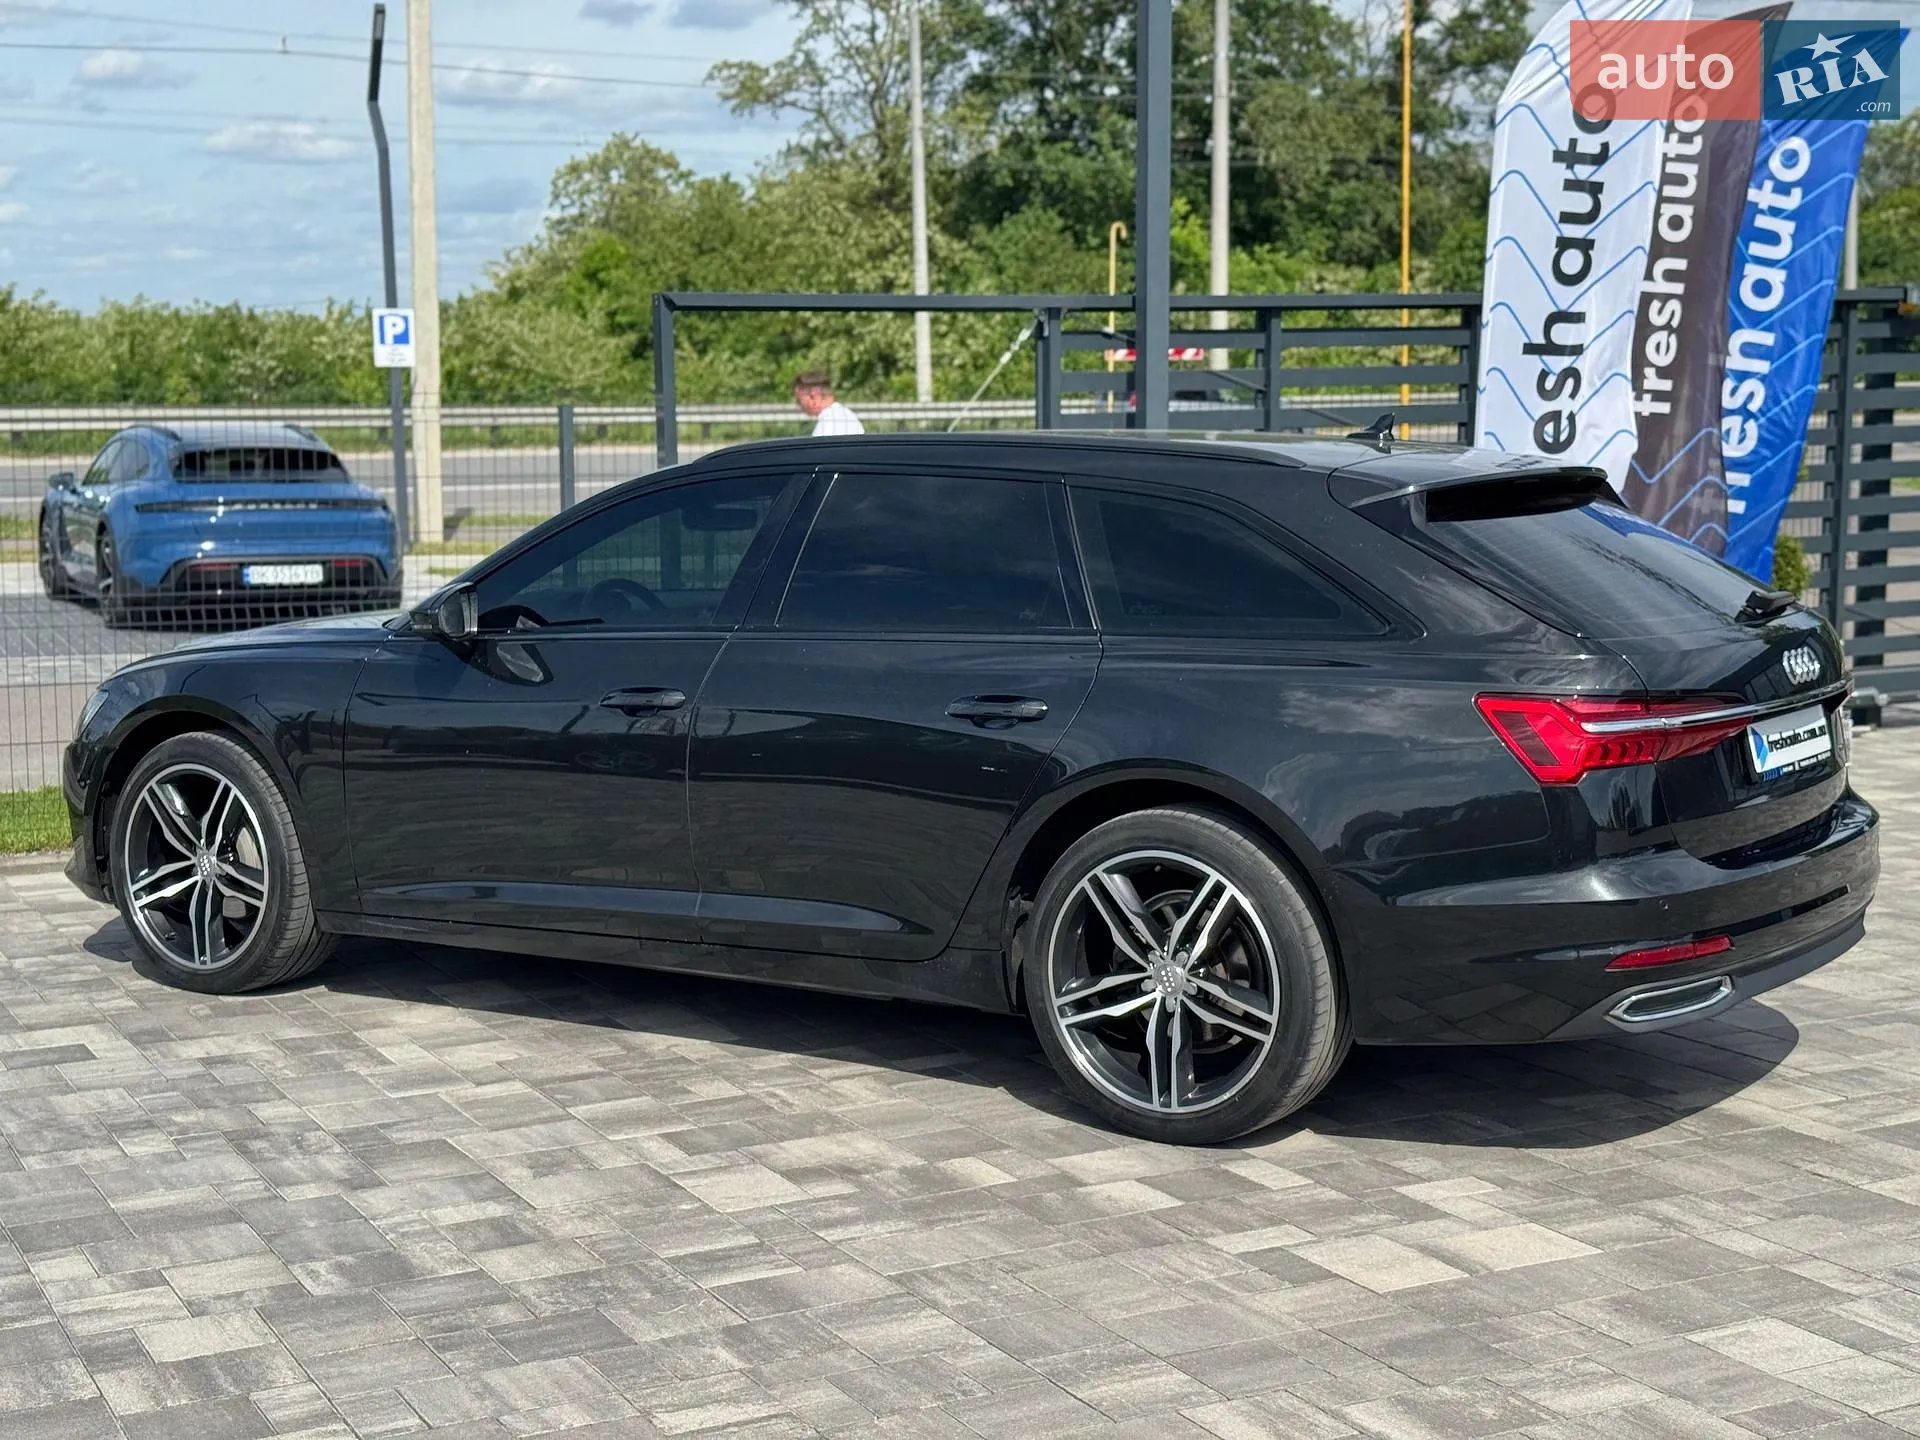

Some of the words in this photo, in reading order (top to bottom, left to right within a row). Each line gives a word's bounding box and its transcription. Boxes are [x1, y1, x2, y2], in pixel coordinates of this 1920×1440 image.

[1552, 83, 1617, 287] auto
[1658, 95, 1708, 243] auto
[1739, 136, 1811, 312] auto
[384, 315, 406, 344] P
[1522, 311, 1586, 455] esh
[1633, 256, 1688, 416] fresh
